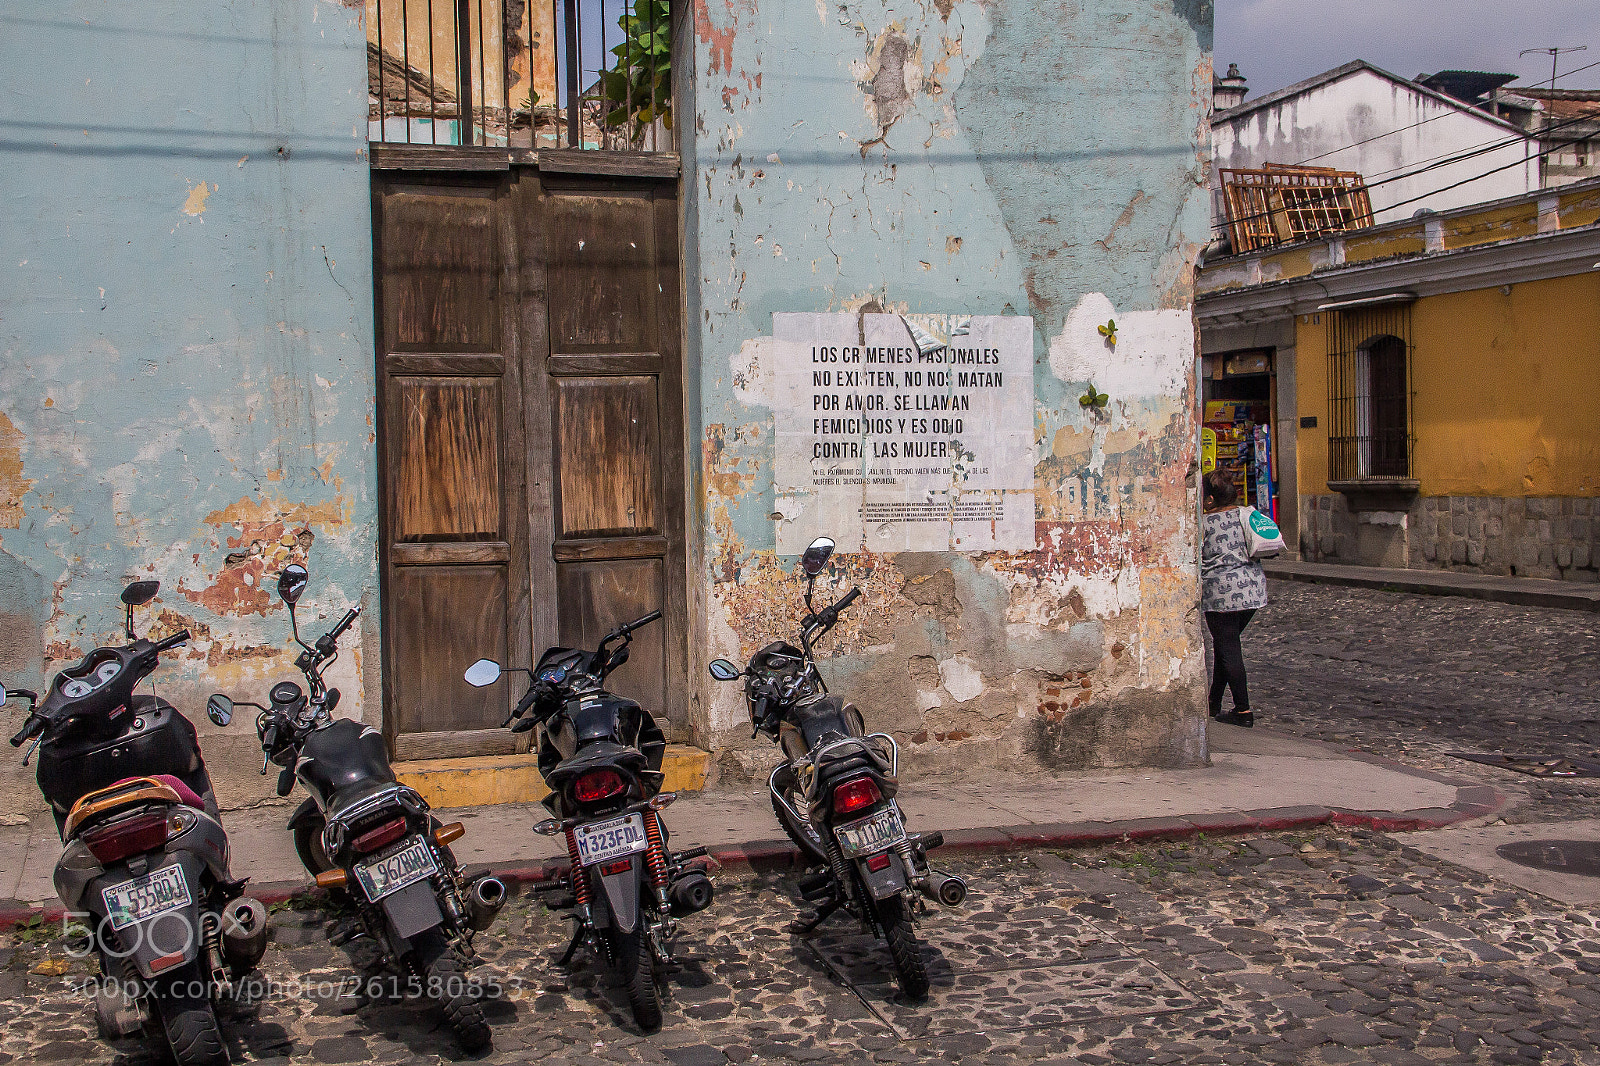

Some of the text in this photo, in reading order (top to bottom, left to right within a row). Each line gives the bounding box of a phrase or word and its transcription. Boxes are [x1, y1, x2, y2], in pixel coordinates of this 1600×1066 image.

[812, 346, 999, 364] LOS CRMENES ASIONALES
[813, 370, 831, 387] NO
[904, 371, 922, 387] NO
[958, 372, 1003, 388] MATAN
[813, 394, 970, 411] POR AMOR. SE LLAMAN
[897, 418, 906, 434] Y
[911, 418, 927, 434] ES
[932, 418, 963, 434] ODIO
[873, 441, 898, 458] LAS
[903, 441, 951, 458] MUJER
